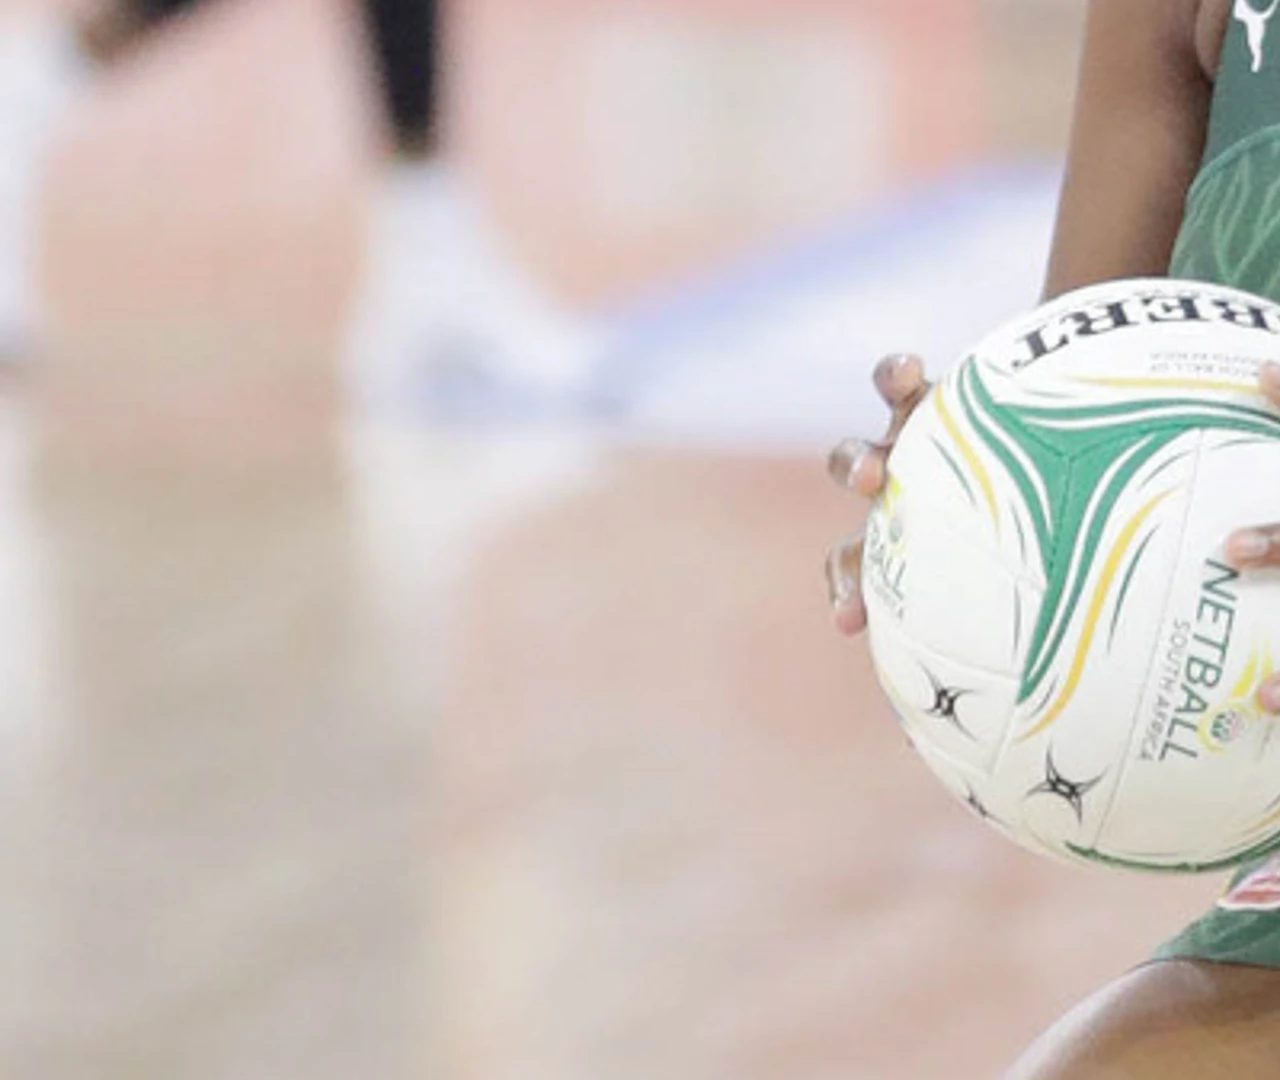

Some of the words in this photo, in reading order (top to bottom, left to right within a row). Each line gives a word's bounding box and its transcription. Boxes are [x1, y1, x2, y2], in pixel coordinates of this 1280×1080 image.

[1158, 557, 1240, 761] NETBALL
[1159, 617, 1191, 693] SOUTH
[1140, 693, 1172, 761] AFRICA
